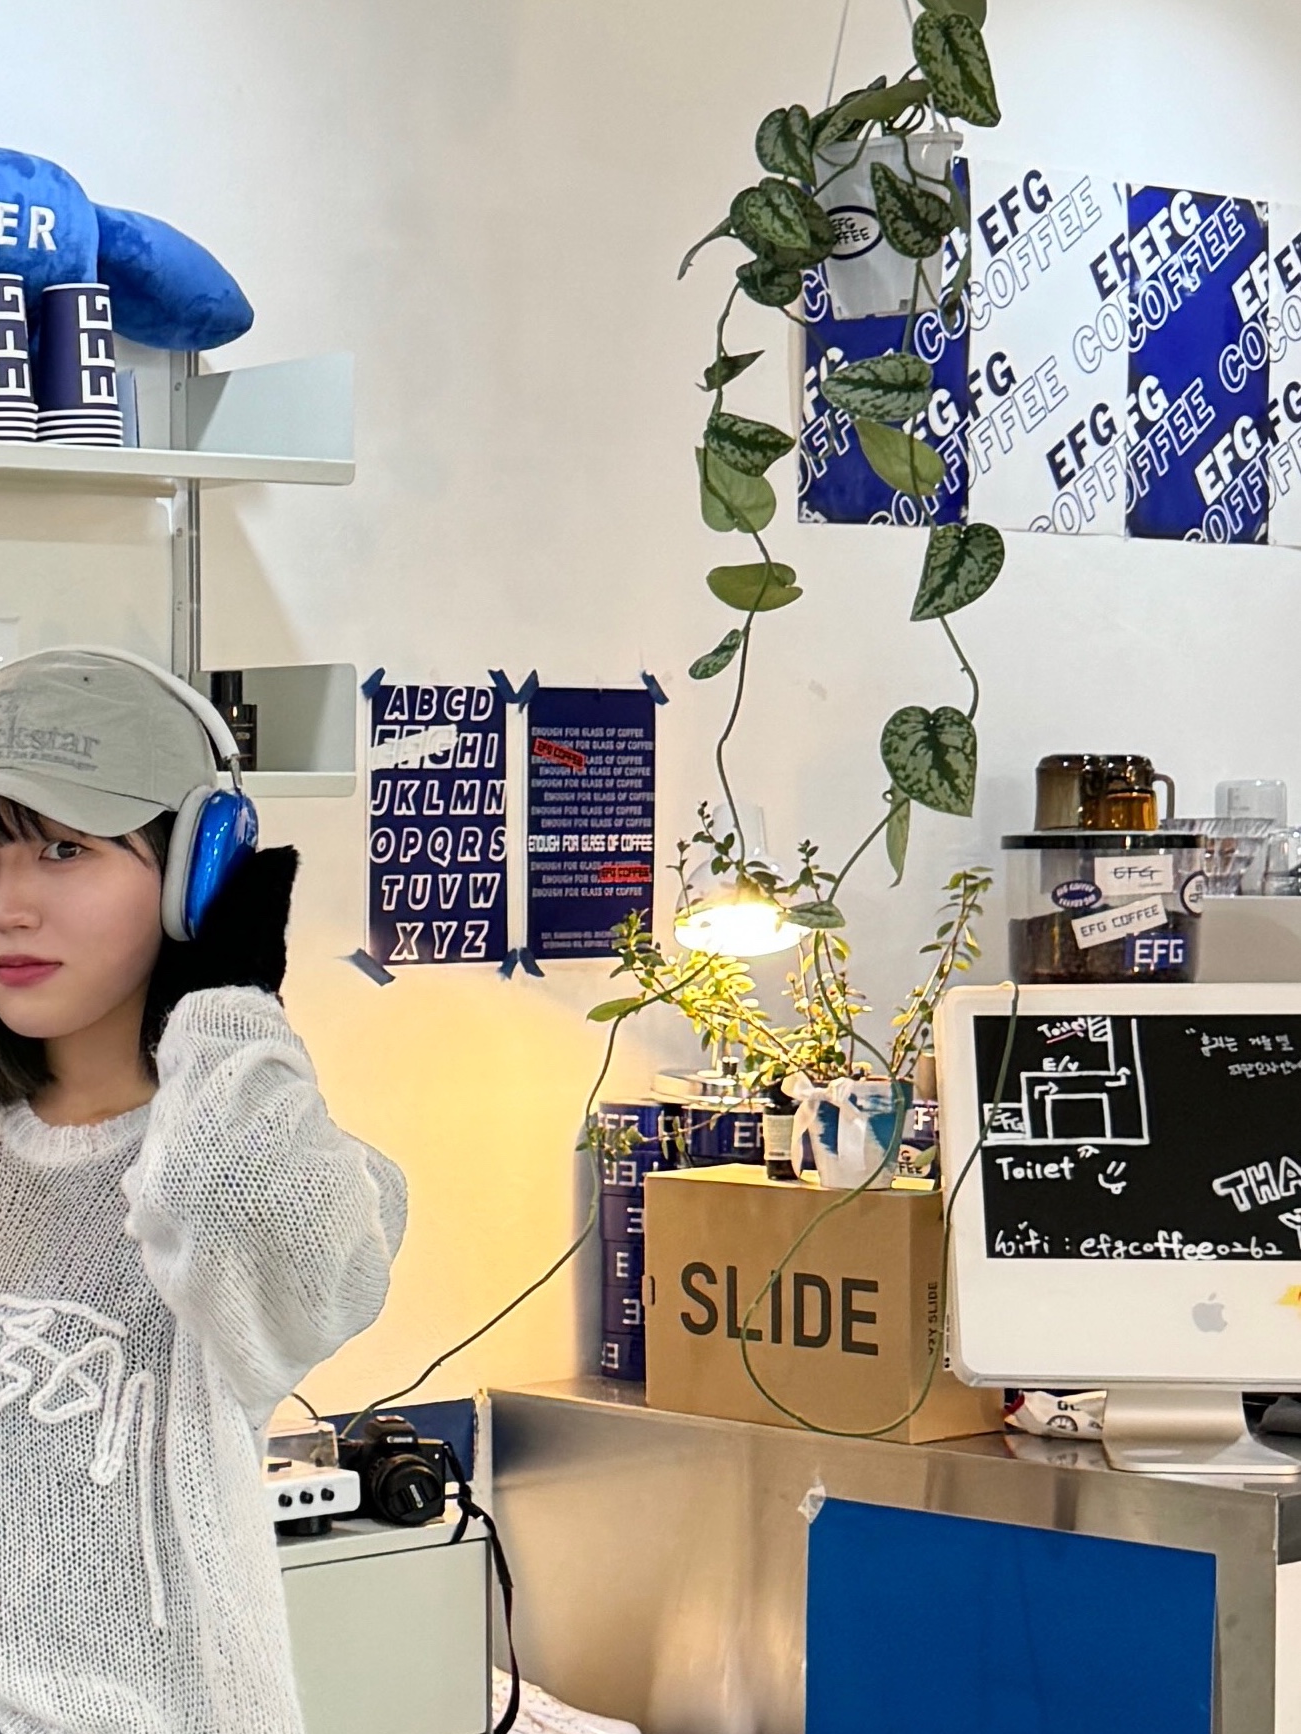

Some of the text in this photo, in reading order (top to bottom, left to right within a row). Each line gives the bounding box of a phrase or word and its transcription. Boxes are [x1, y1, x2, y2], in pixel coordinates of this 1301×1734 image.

[969, 175, 1103, 331] COFFEE
[977, 169, 1053, 257] EFG
[1129, 191, 1201, 280] EFG
[78, 294, 118, 405] EFG
[1045, 402, 1118, 491] EFG
[1195, 415, 1261, 505] EFG
[528, 834, 652, 852] ENOUGH FOR GLASS OF COFFEE
[1080, 903, 1160, 937] EFG COFFEE
[1134, 938, 1185, 964] EFG
[995, 1156, 1075, 1181] Toilet
[680, 1262, 879, 1357] SLIDE
[927, 1281, 939, 1324] SLIDE
